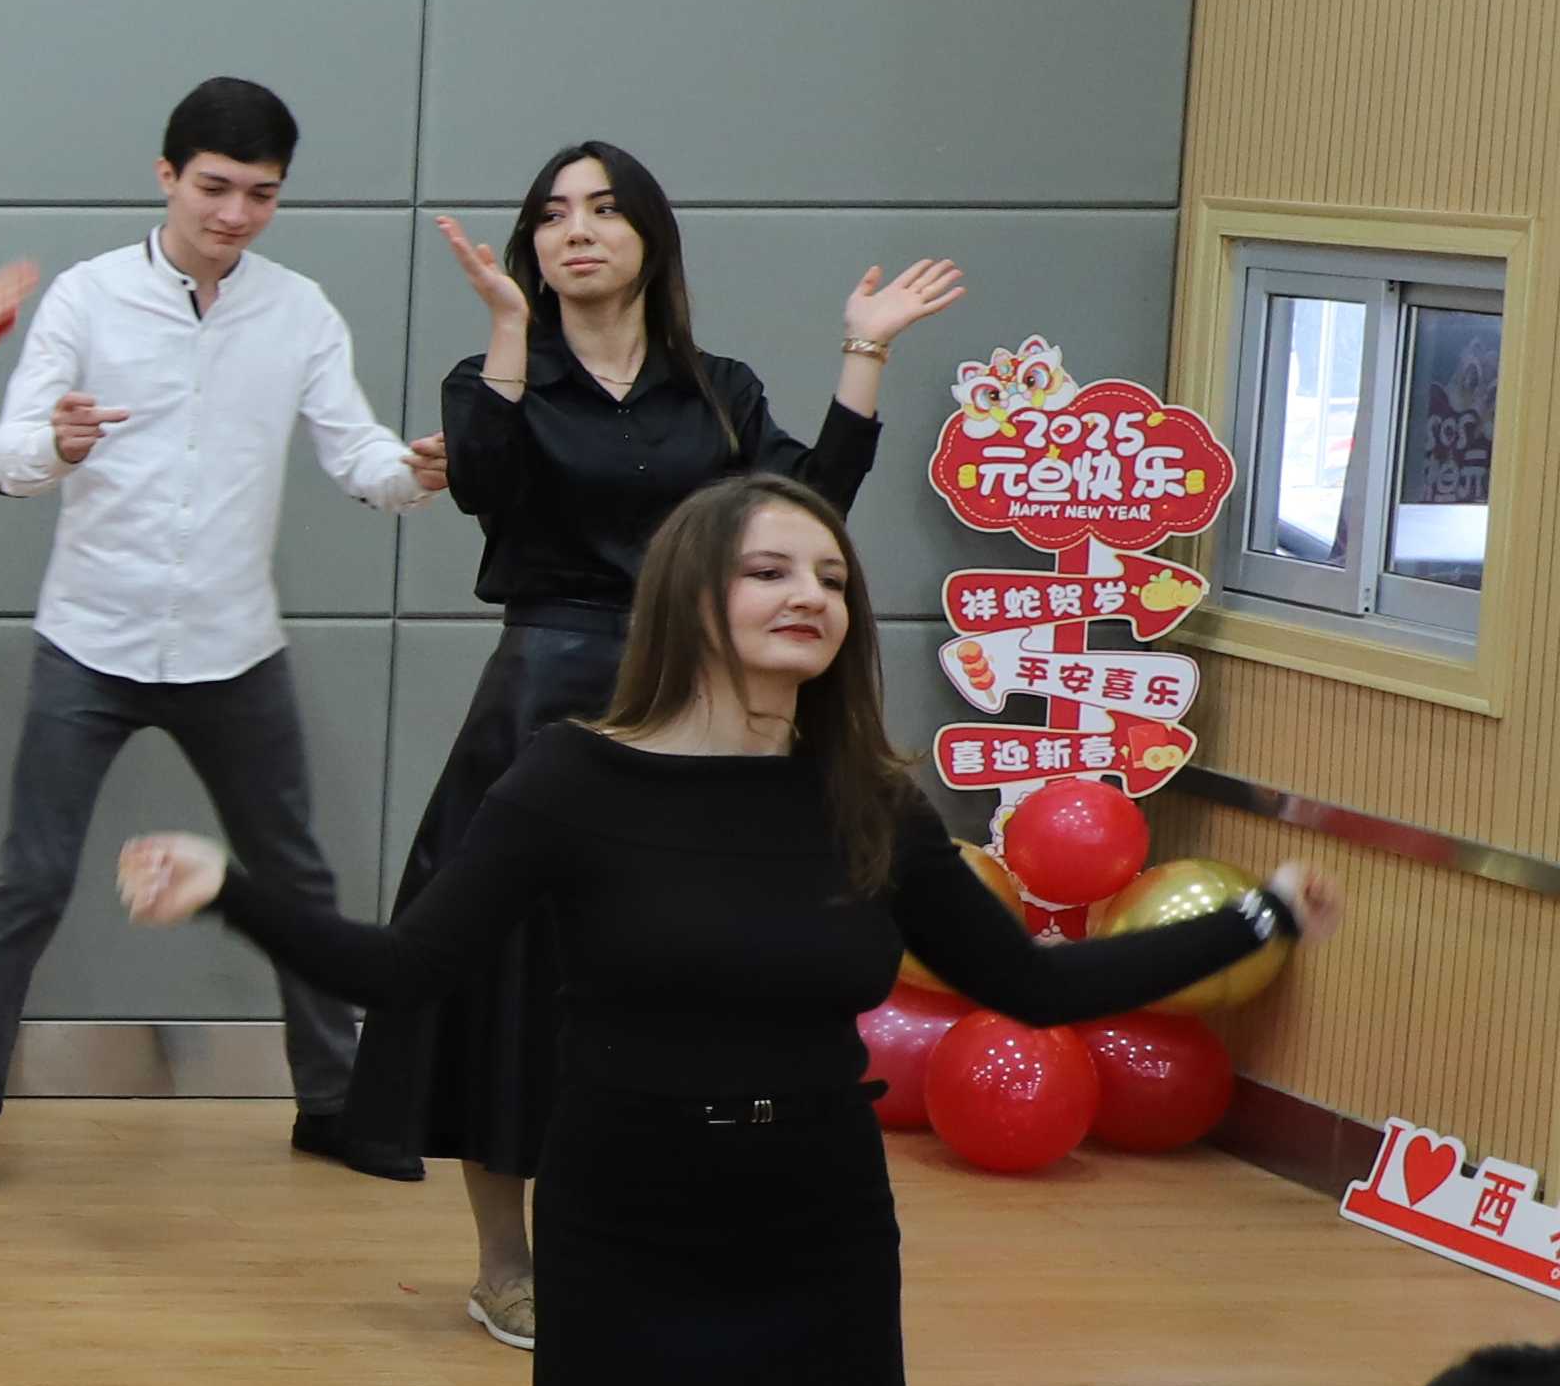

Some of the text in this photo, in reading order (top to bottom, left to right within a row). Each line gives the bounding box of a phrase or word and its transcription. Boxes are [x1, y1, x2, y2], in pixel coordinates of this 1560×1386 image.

[1012, 411, 1146, 457] 2025
[978, 445, 1186, 502] 元旦快乐
[1008, 500, 1152, 522] HAPPY NEW YEAR
[960, 580, 1128, 621] 祥蛇贺岁
[1015, 656, 1181, 707] 平安喜乐
[950, 735, 1117, 775] 喜迎新春
